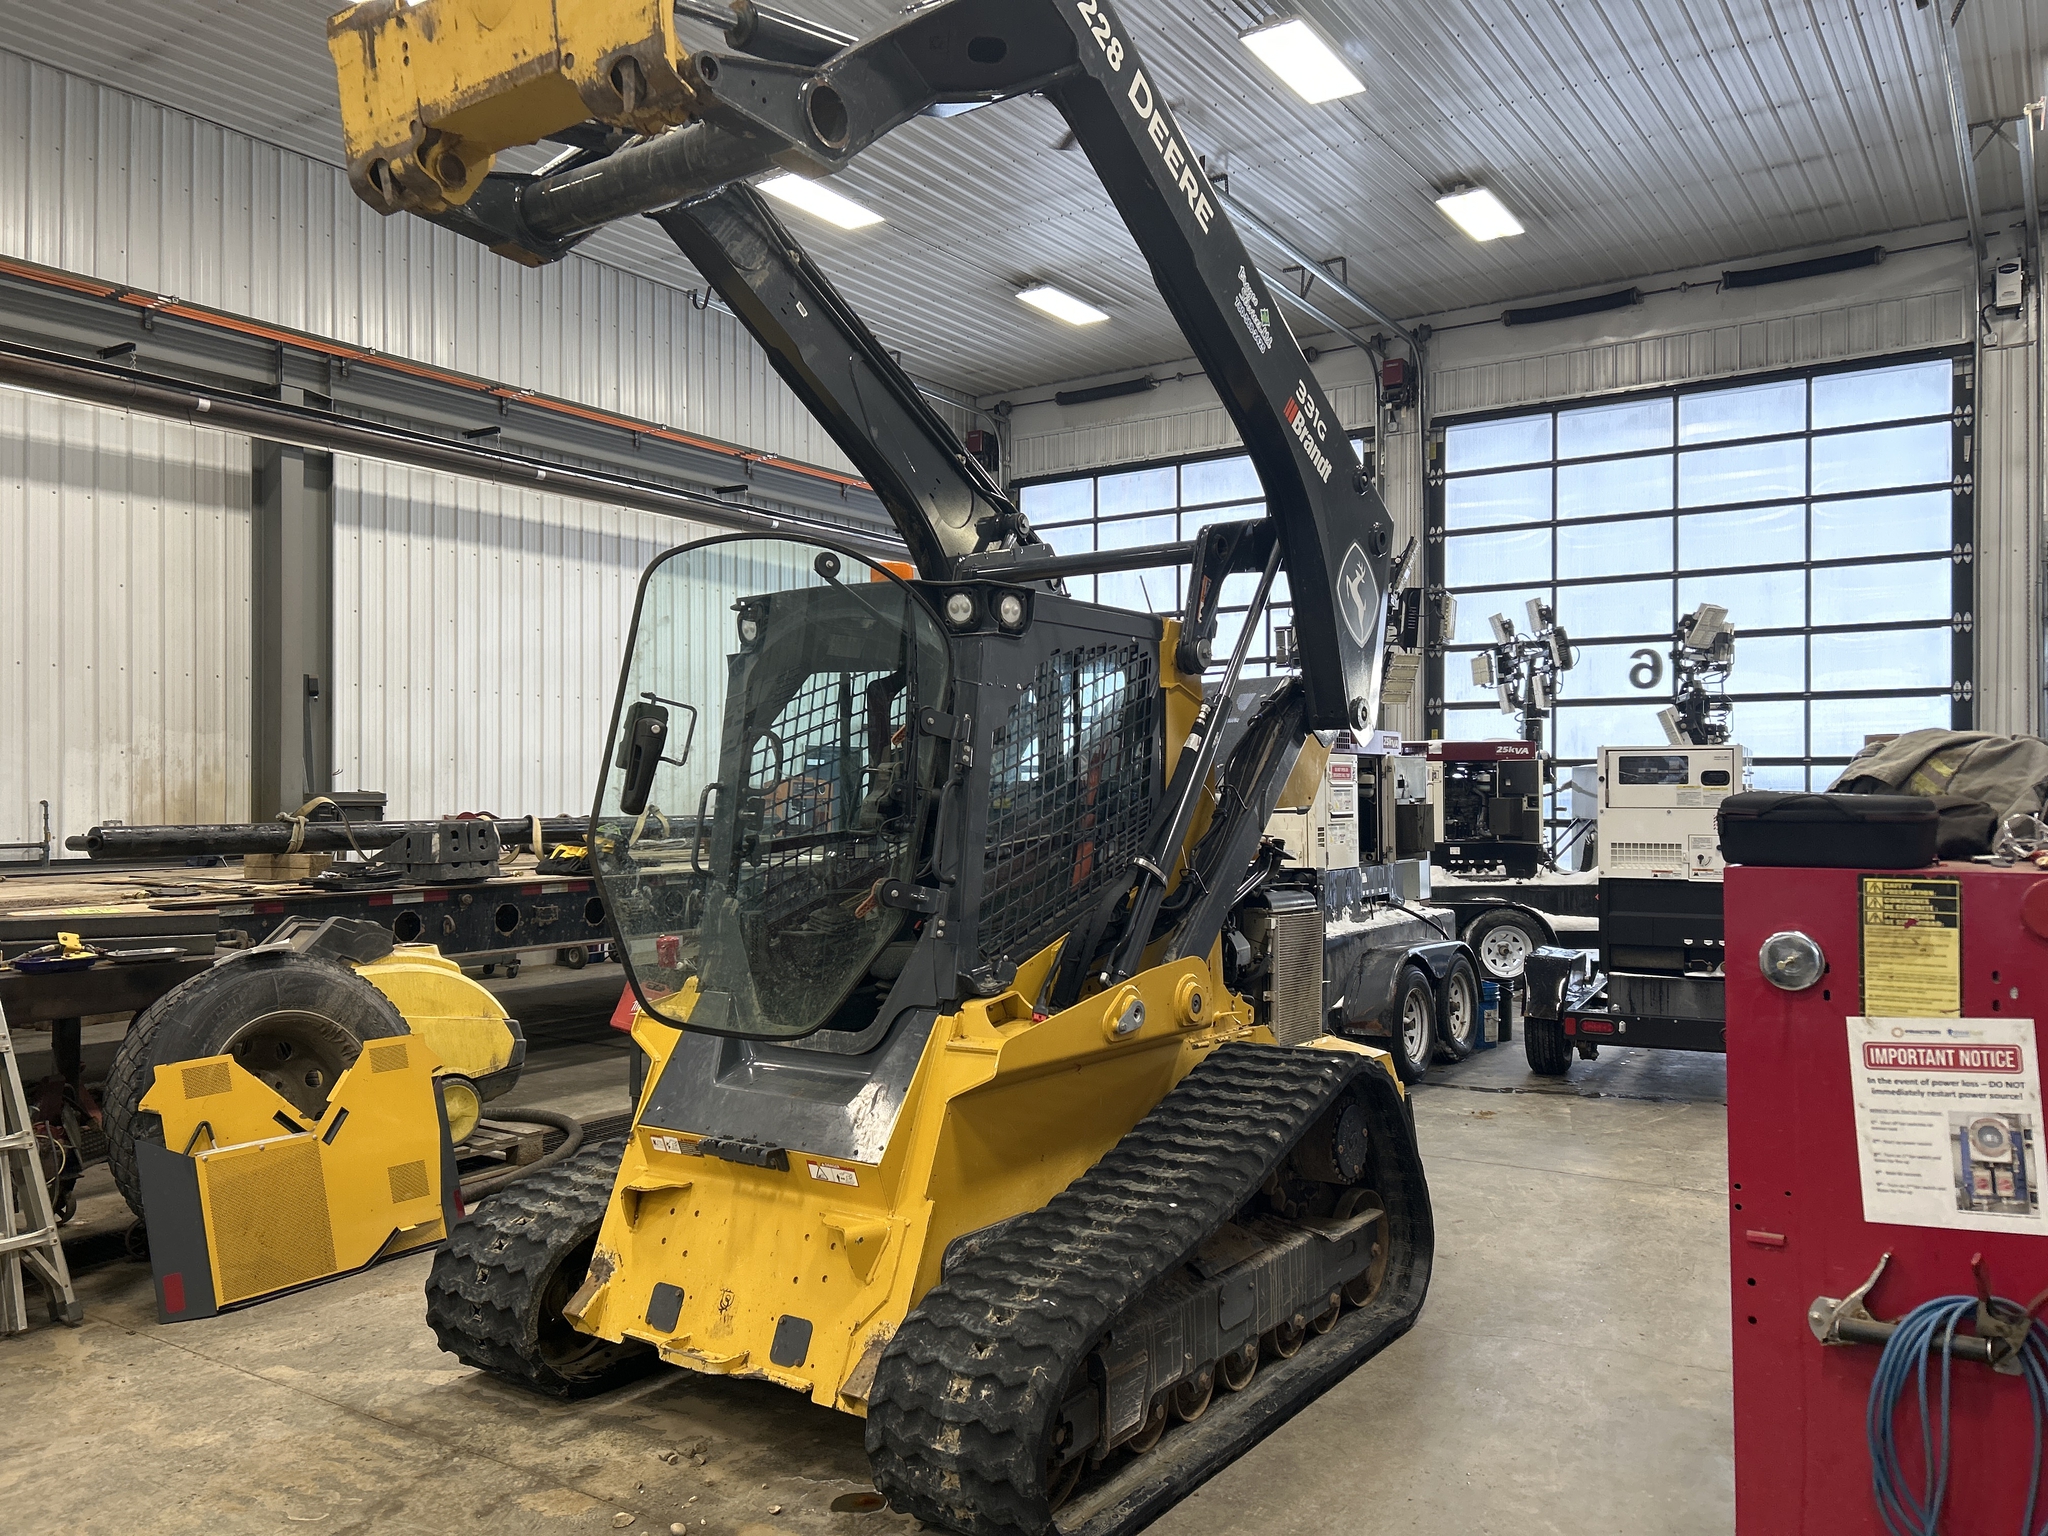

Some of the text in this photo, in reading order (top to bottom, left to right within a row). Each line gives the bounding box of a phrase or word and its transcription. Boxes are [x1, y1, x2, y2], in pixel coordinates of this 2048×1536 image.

[1128, 68, 1215, 235] DEERE
[1295, 379, 1327, 442] 331G
[1291, 410, 1333, 484] Brandt
[1496, 746, 1529, 755] 25kVA
[1869, 1047, 2016, 1068] IMPORTANT NOTICE
[1927, 1090, 1956, 1098] restart
[1961, 1080, 1979, 1088] loss
